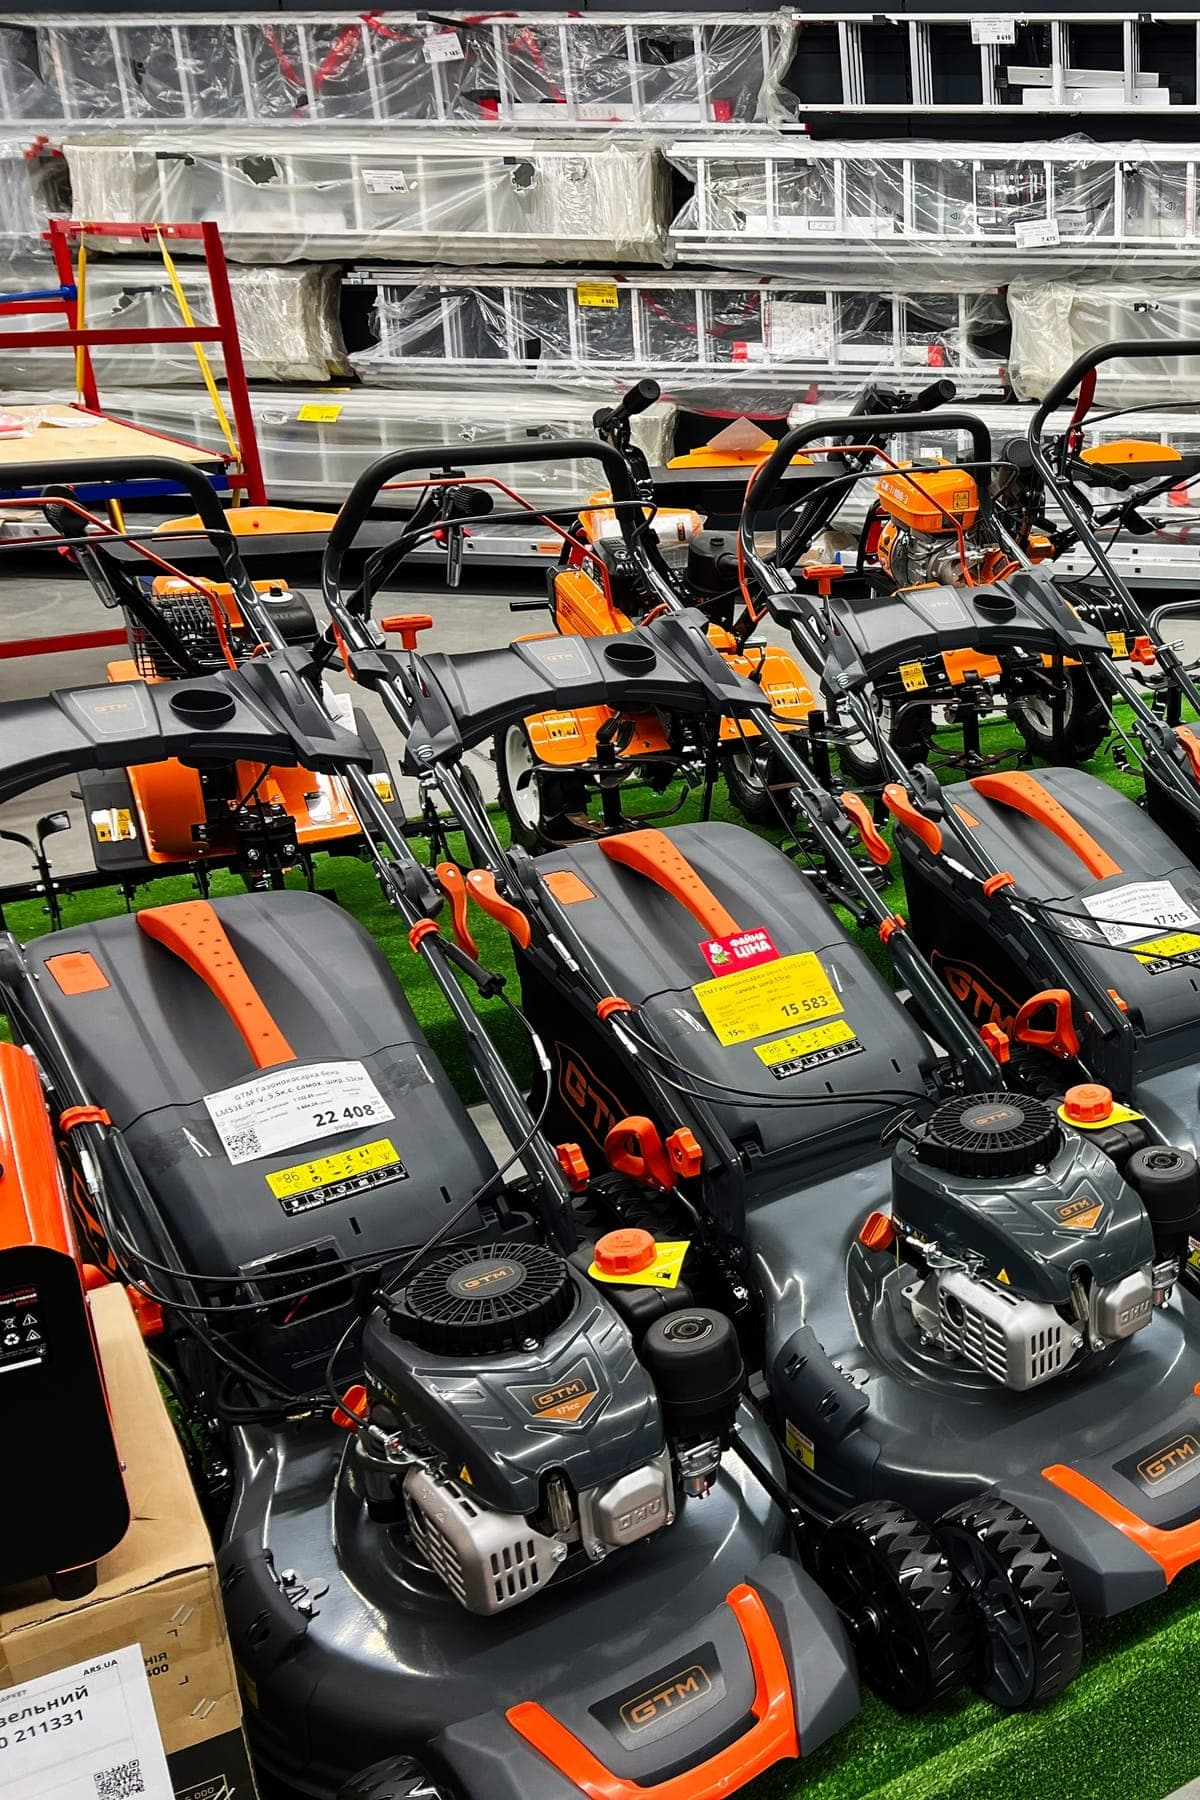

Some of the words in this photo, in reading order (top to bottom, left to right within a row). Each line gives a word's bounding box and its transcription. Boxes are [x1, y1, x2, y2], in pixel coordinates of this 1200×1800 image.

[729, 931, 768, 948] ФАЙНА
[781, 1004, 799, 1018] 15
[802, 994, 828, 1011] 583
[313, 1110, 339, 1127] 22
[342, 1103, 376, 1119] 408
[1059, 1198, 1091, 1217] GTM
[464, 1270, 508, 1289] GTM
[538, 1382, 581, 1406] GTM
[1146, 1443, 1195, 1478] GTM
[83, 1658, 119, 1677] ARS.UA
[630, 1675, 700, 1725] GTM
[15, 1708, 85, 1744] 211331
